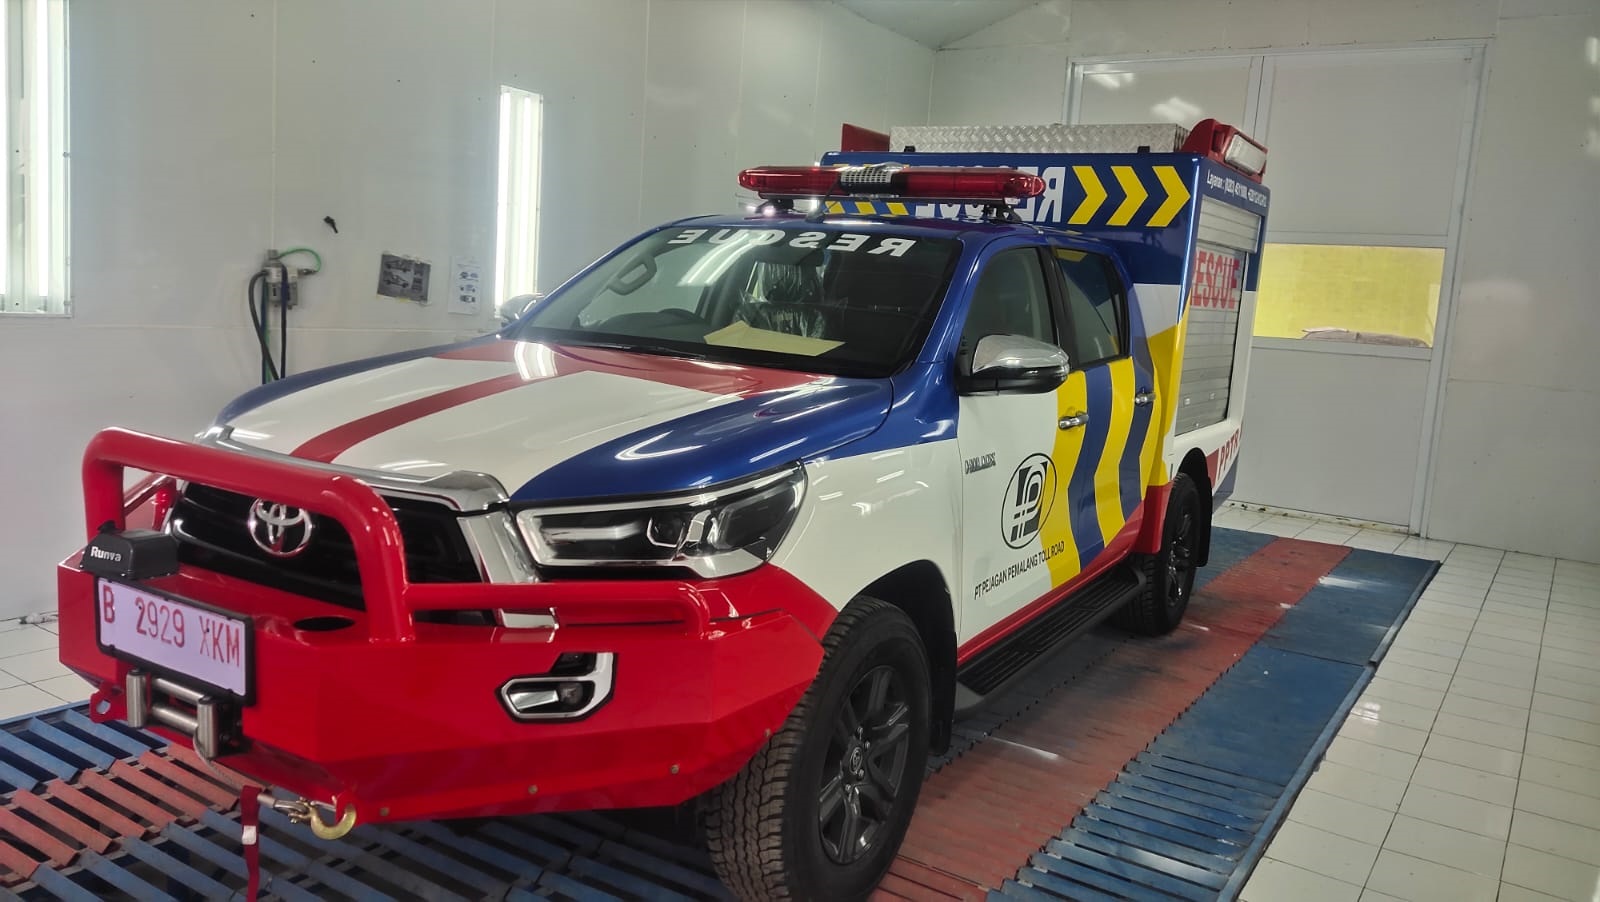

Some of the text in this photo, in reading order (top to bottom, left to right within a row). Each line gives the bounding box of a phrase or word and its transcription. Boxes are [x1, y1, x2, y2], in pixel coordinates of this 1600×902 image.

[90, 546, 122, 562] Runva
[974, 541, 1065, 600] PT PEJAGAN PEMALANG TOLL ROAD
[102, 585, 240, 667] B 2929 XKM
